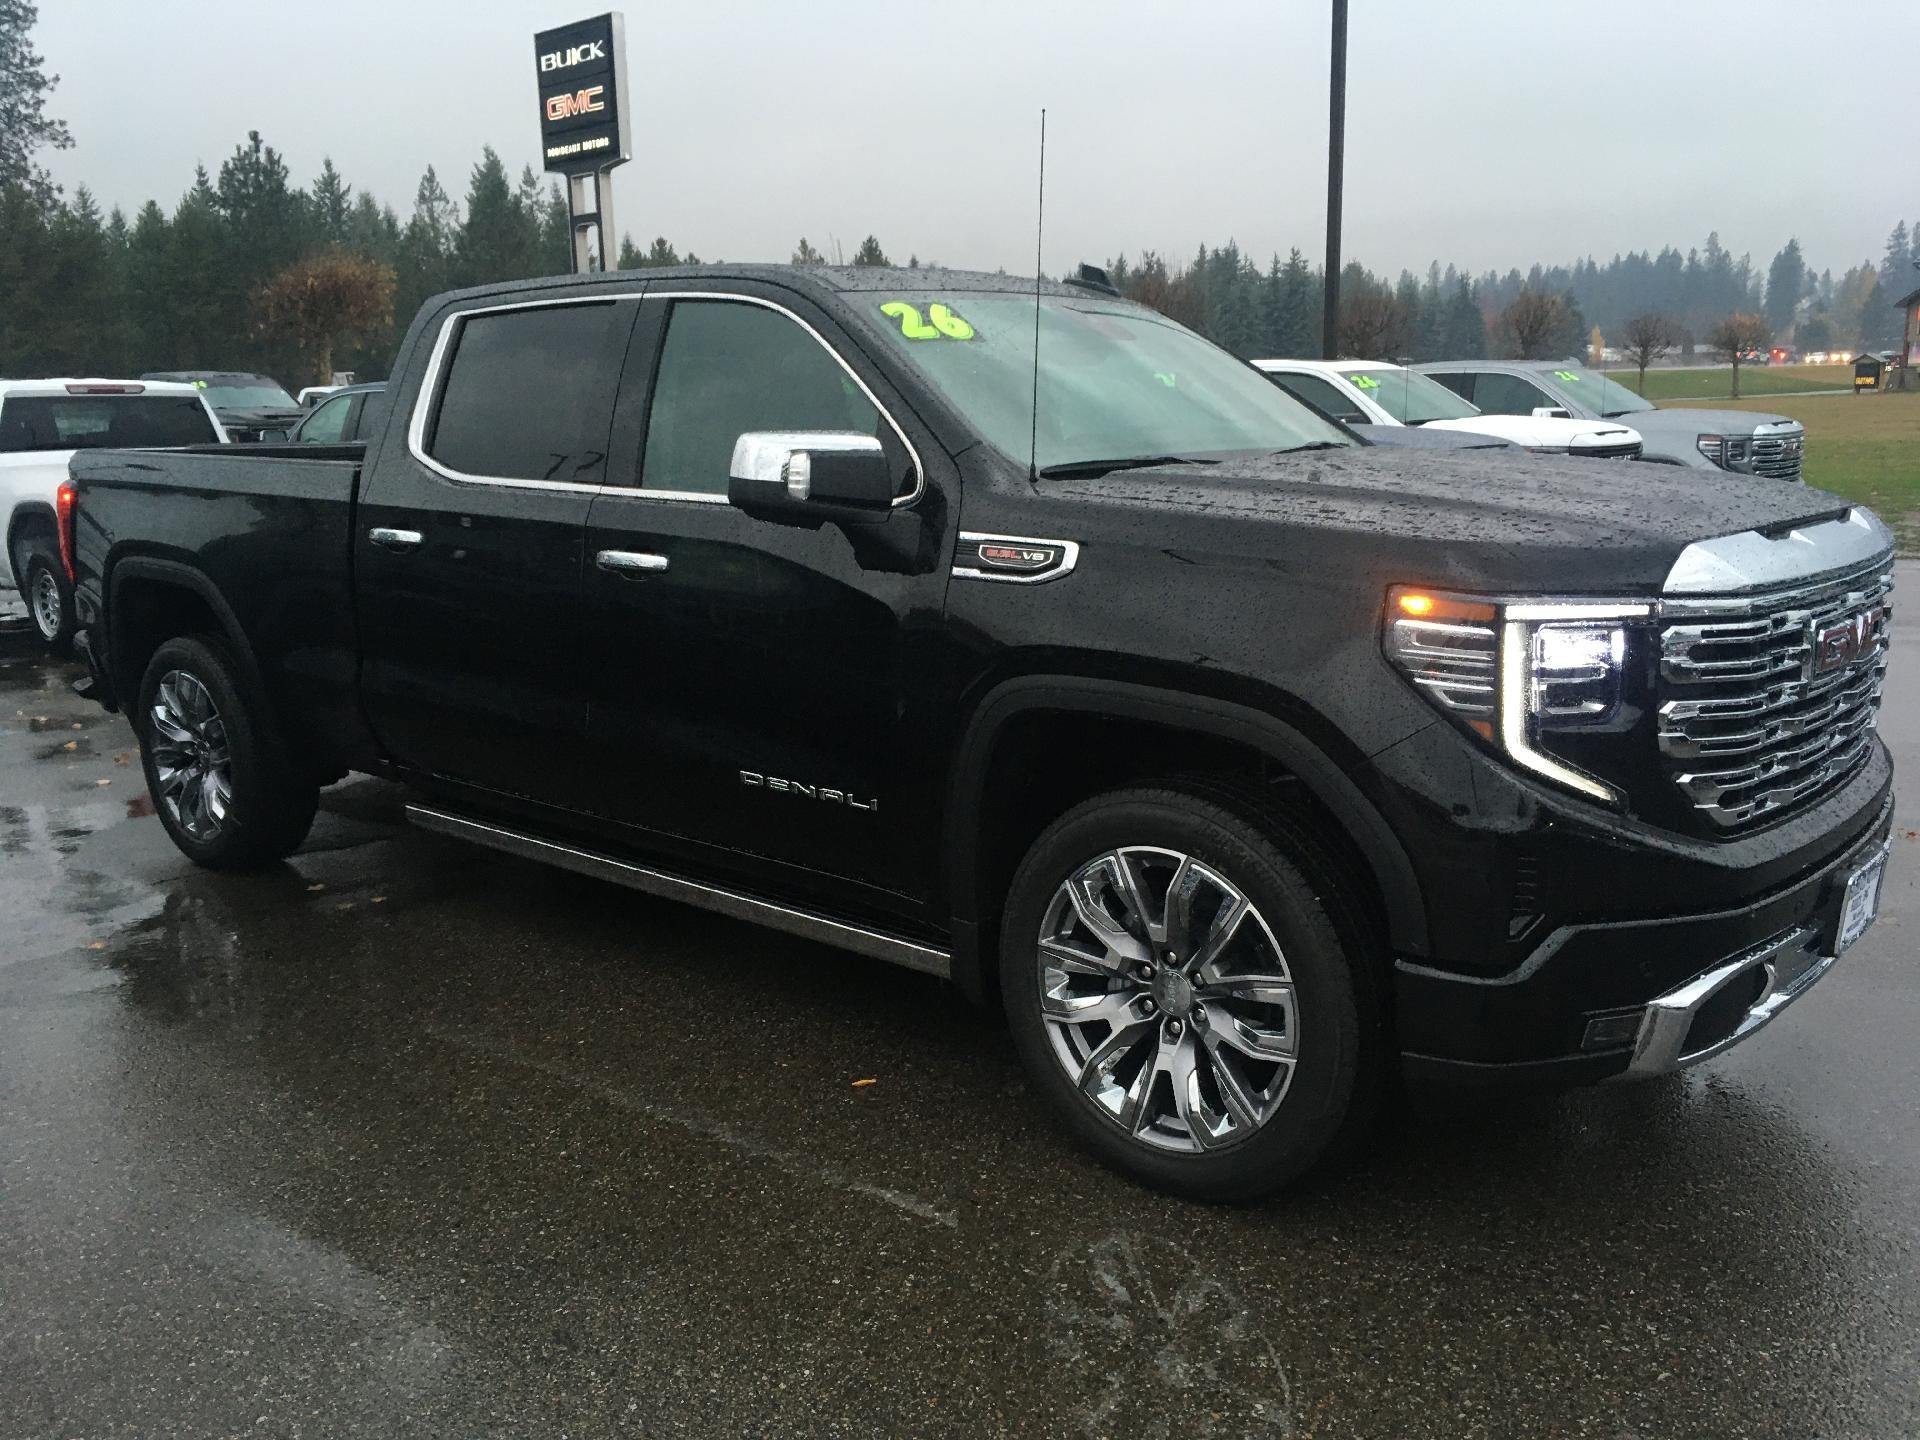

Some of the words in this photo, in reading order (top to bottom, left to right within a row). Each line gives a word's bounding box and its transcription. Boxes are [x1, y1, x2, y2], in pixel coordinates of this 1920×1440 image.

[541, 40, 605, 72] BUICK
[547, 85, 604, 121] GMC
[880, 301, 975, 340] 26
[1022, 551, 1045, 561] V8
[739, 770, 878, 811] DENALI
